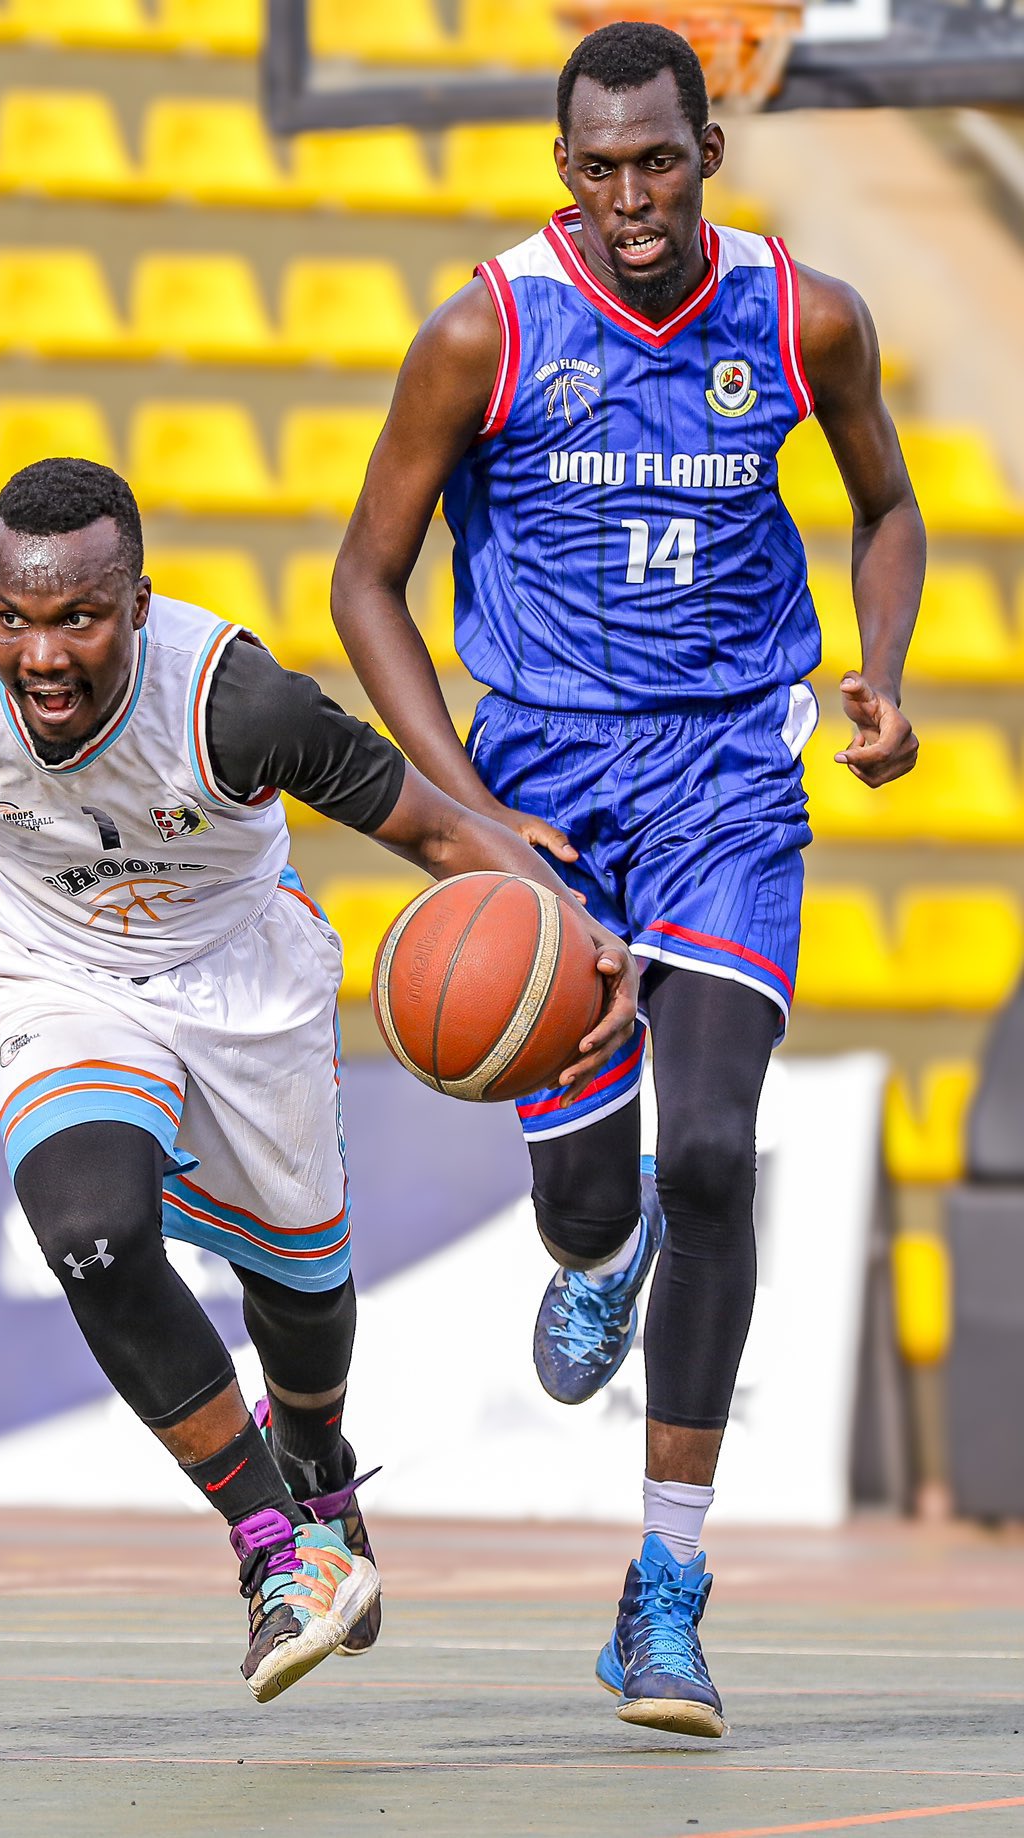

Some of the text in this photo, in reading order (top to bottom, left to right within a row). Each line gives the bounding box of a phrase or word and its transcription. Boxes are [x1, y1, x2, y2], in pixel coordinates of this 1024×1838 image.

[534, 358, 601, 382] UMU FLAMES
[548, 451, 760, 488] UMU FLAMES
[620, 517, 697, 586] 14
[9, 816, 55, 828] KETBALL
[80, 805, 123, 851] 1
[406, 905, 457, 1004] molten
